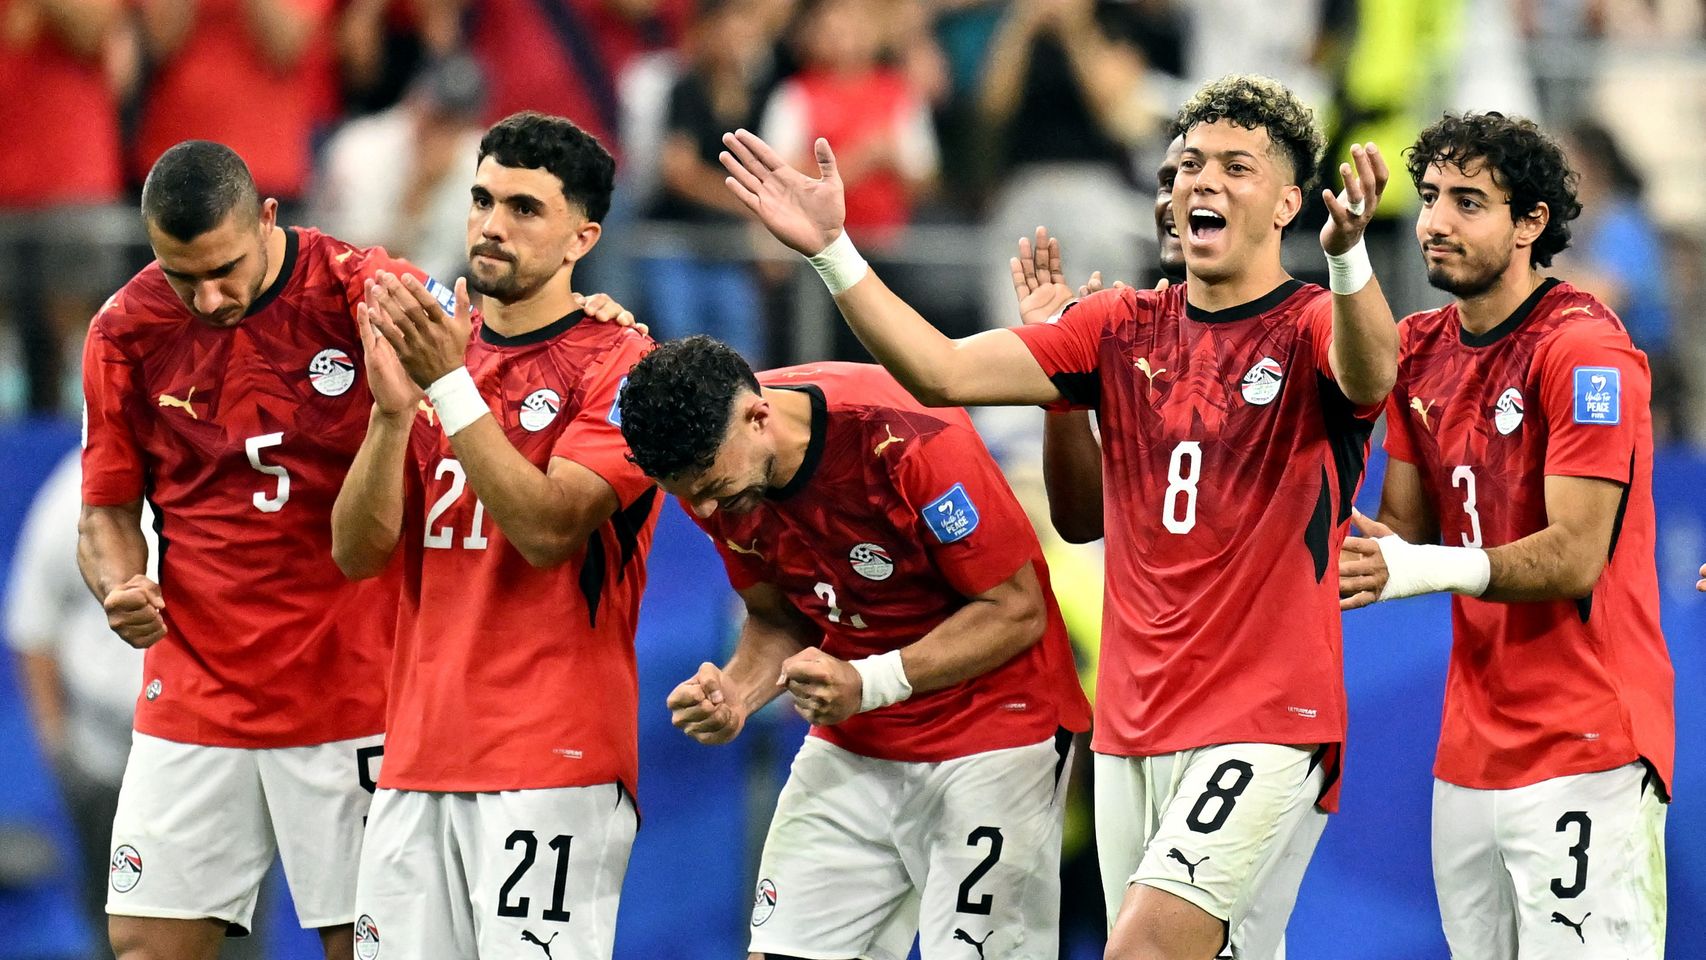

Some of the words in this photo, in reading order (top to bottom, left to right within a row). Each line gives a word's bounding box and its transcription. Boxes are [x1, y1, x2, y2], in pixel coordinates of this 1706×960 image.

[1586, 402, 1610, 413] PEACE
[245, 431, 291, 513] 5
[423, 458, 488, 550] 21
[1162, 441, 1203, 534] 8
[1451, 465, 1483, 548] 3
[945, 515, 969, 534] PEACE
[1186, 758, 1254, 834] 8
[497, 829, 574, 922] 21
[956, 826, 1004, 915] 2
[1550, 811, 1592, 899] 3
